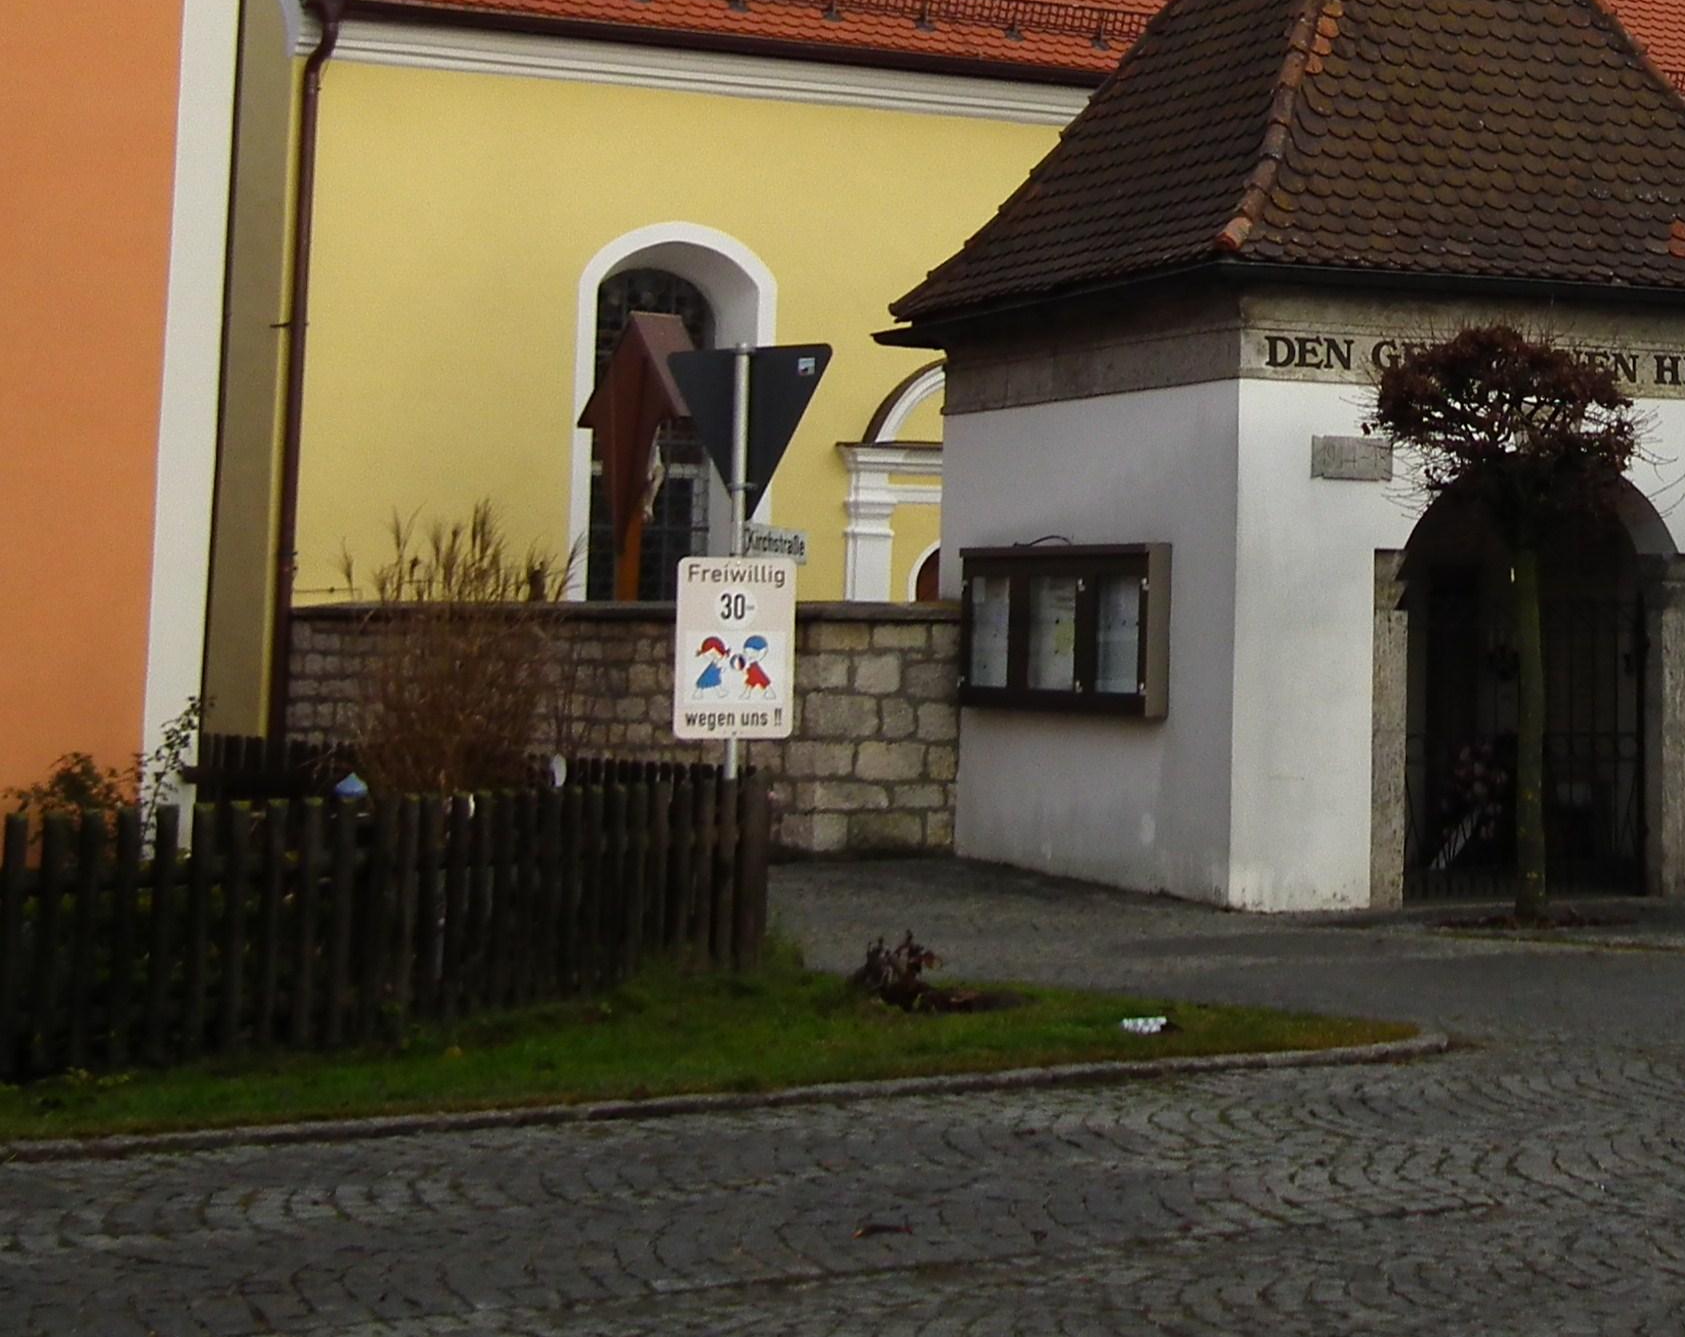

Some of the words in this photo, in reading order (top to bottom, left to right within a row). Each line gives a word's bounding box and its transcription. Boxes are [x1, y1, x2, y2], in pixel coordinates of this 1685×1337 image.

[1265, 335, 1354, 370] DEN
[687, 563, 786, 588] Freiwillig
[720, 593, 746, 620] 30
[685, 712, 735, 731] wegen
[741, 712, 769, 726] uns
